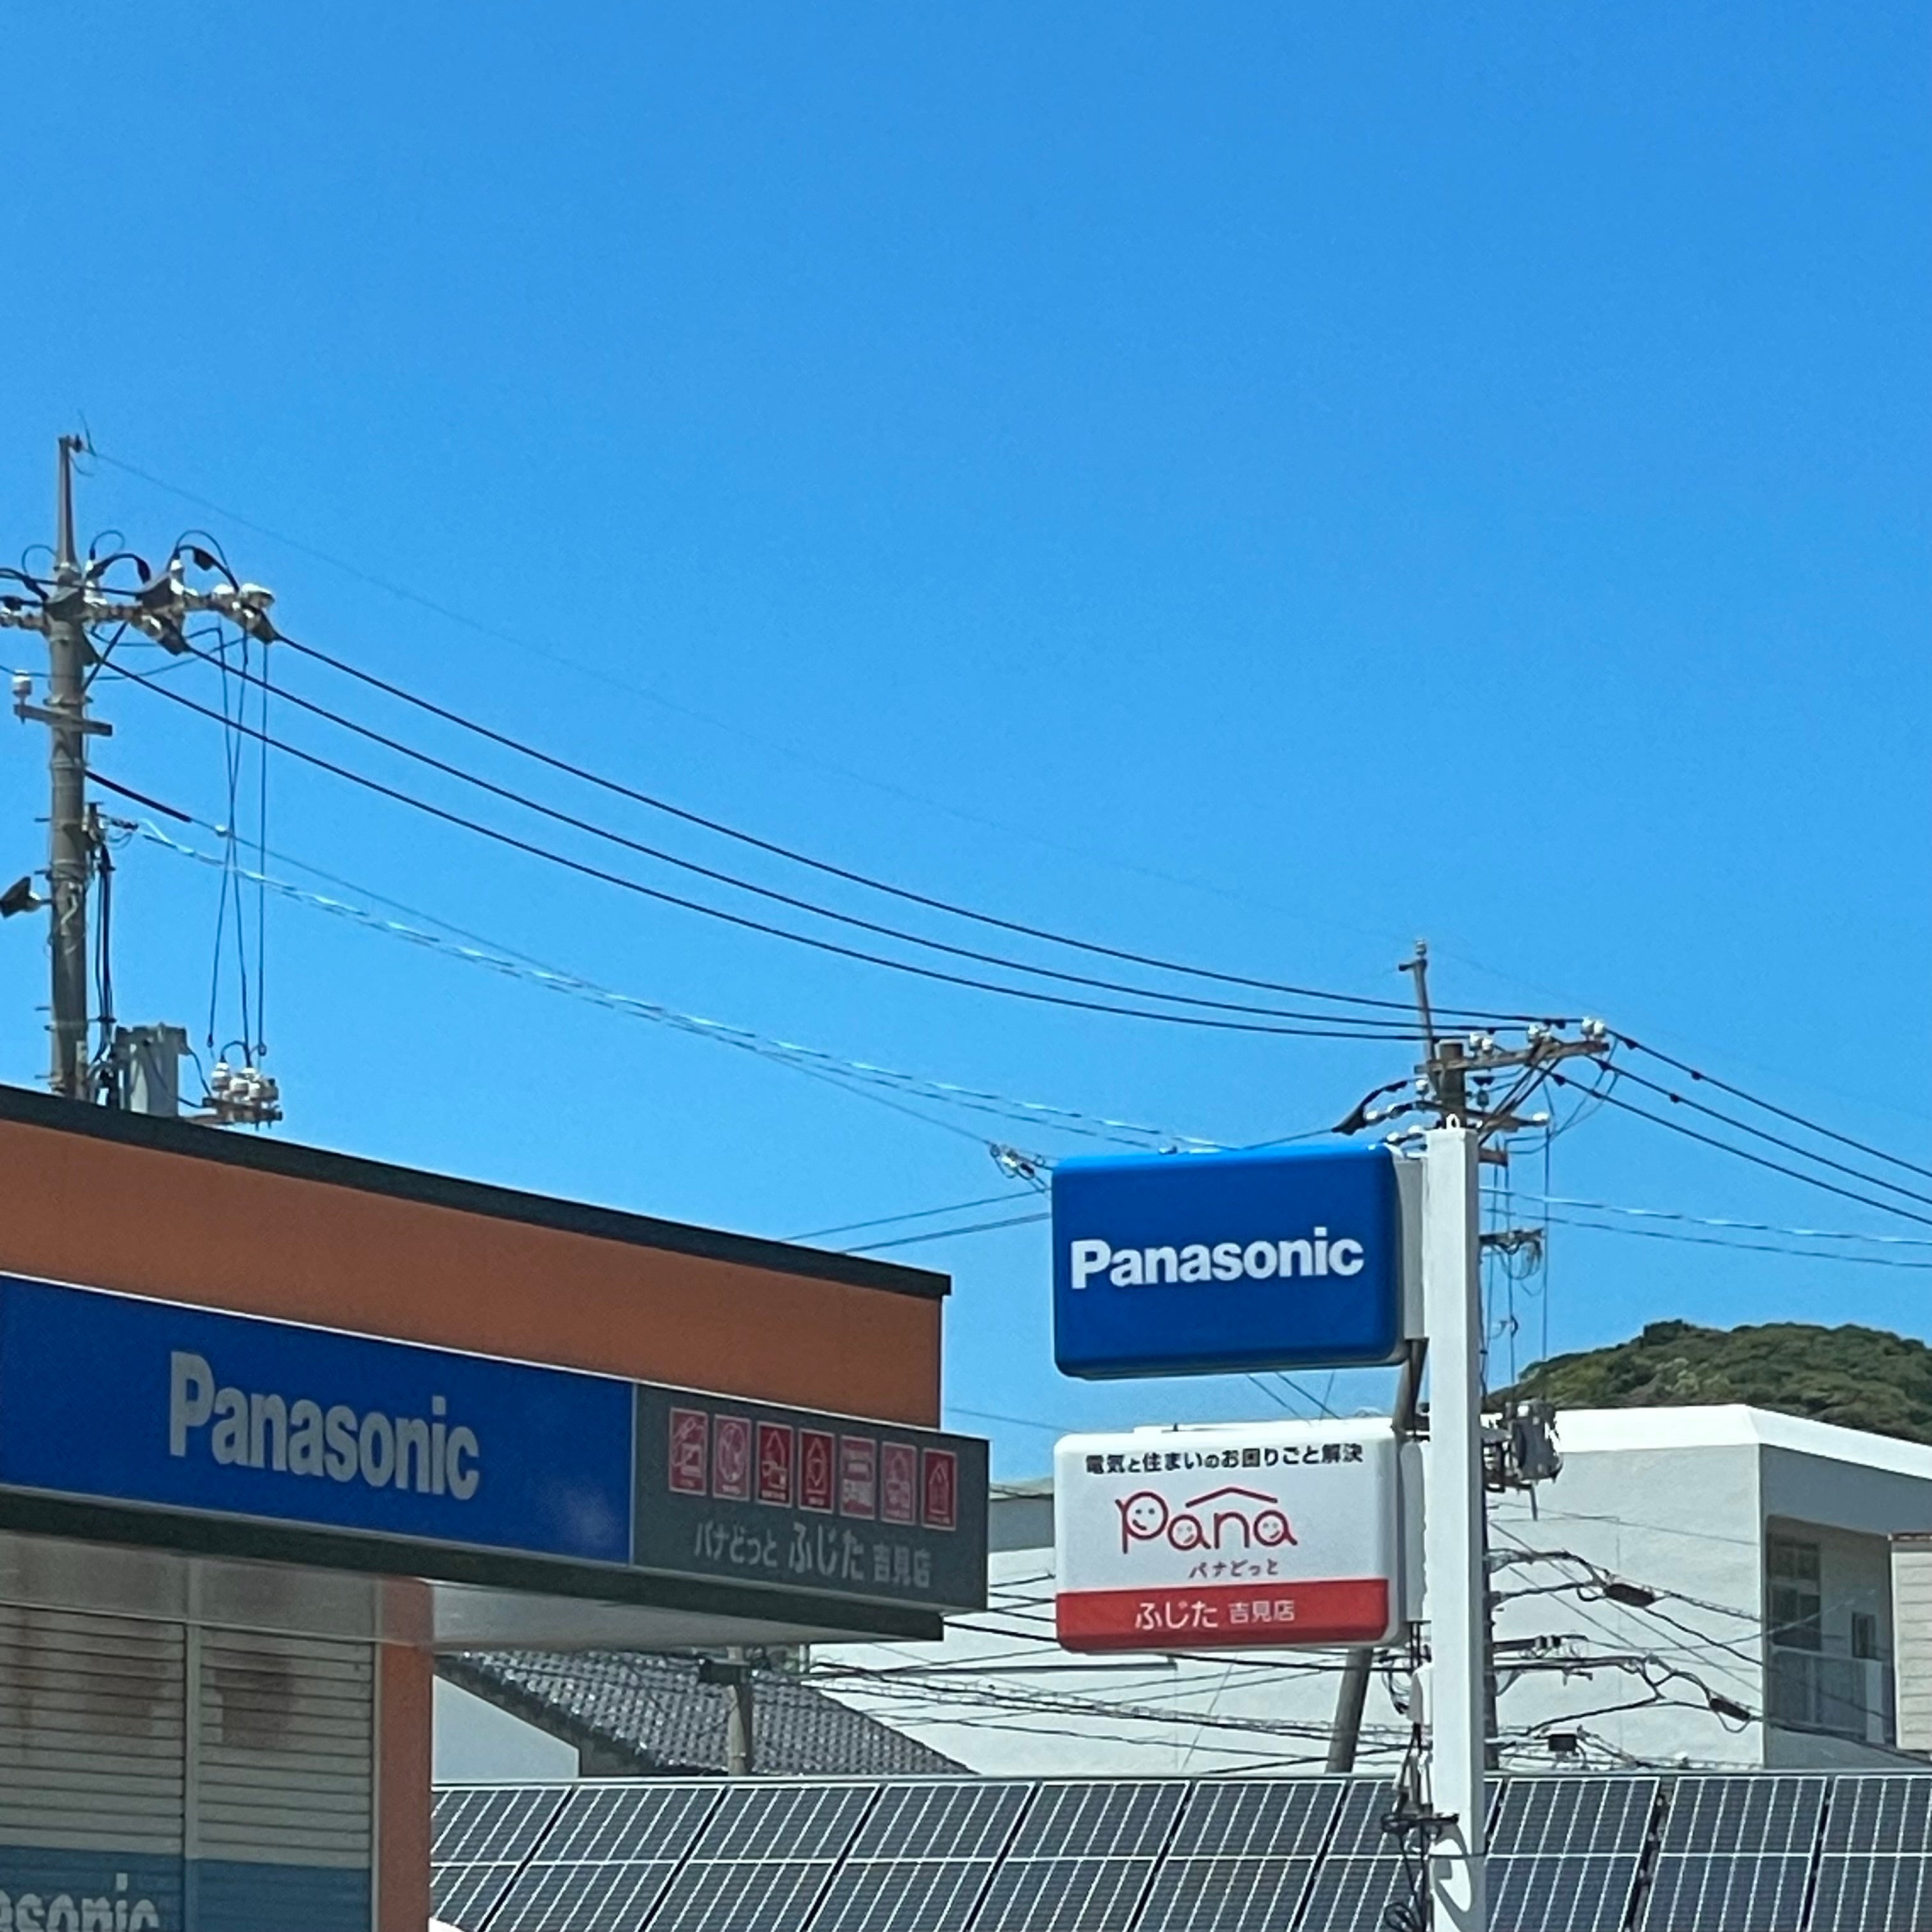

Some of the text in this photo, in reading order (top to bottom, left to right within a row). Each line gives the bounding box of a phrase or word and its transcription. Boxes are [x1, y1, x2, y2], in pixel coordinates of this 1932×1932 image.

[1071, 1226, 1364, 1289] Panasonic
[169, 1351, 479, 1500] Panasonic
[788, 1521, 864, 1581] ふじた
[1188, 1558, 1279, 1579] パナどっと
[1135, 1600, 1295, 1630] ふじた 吉見店
